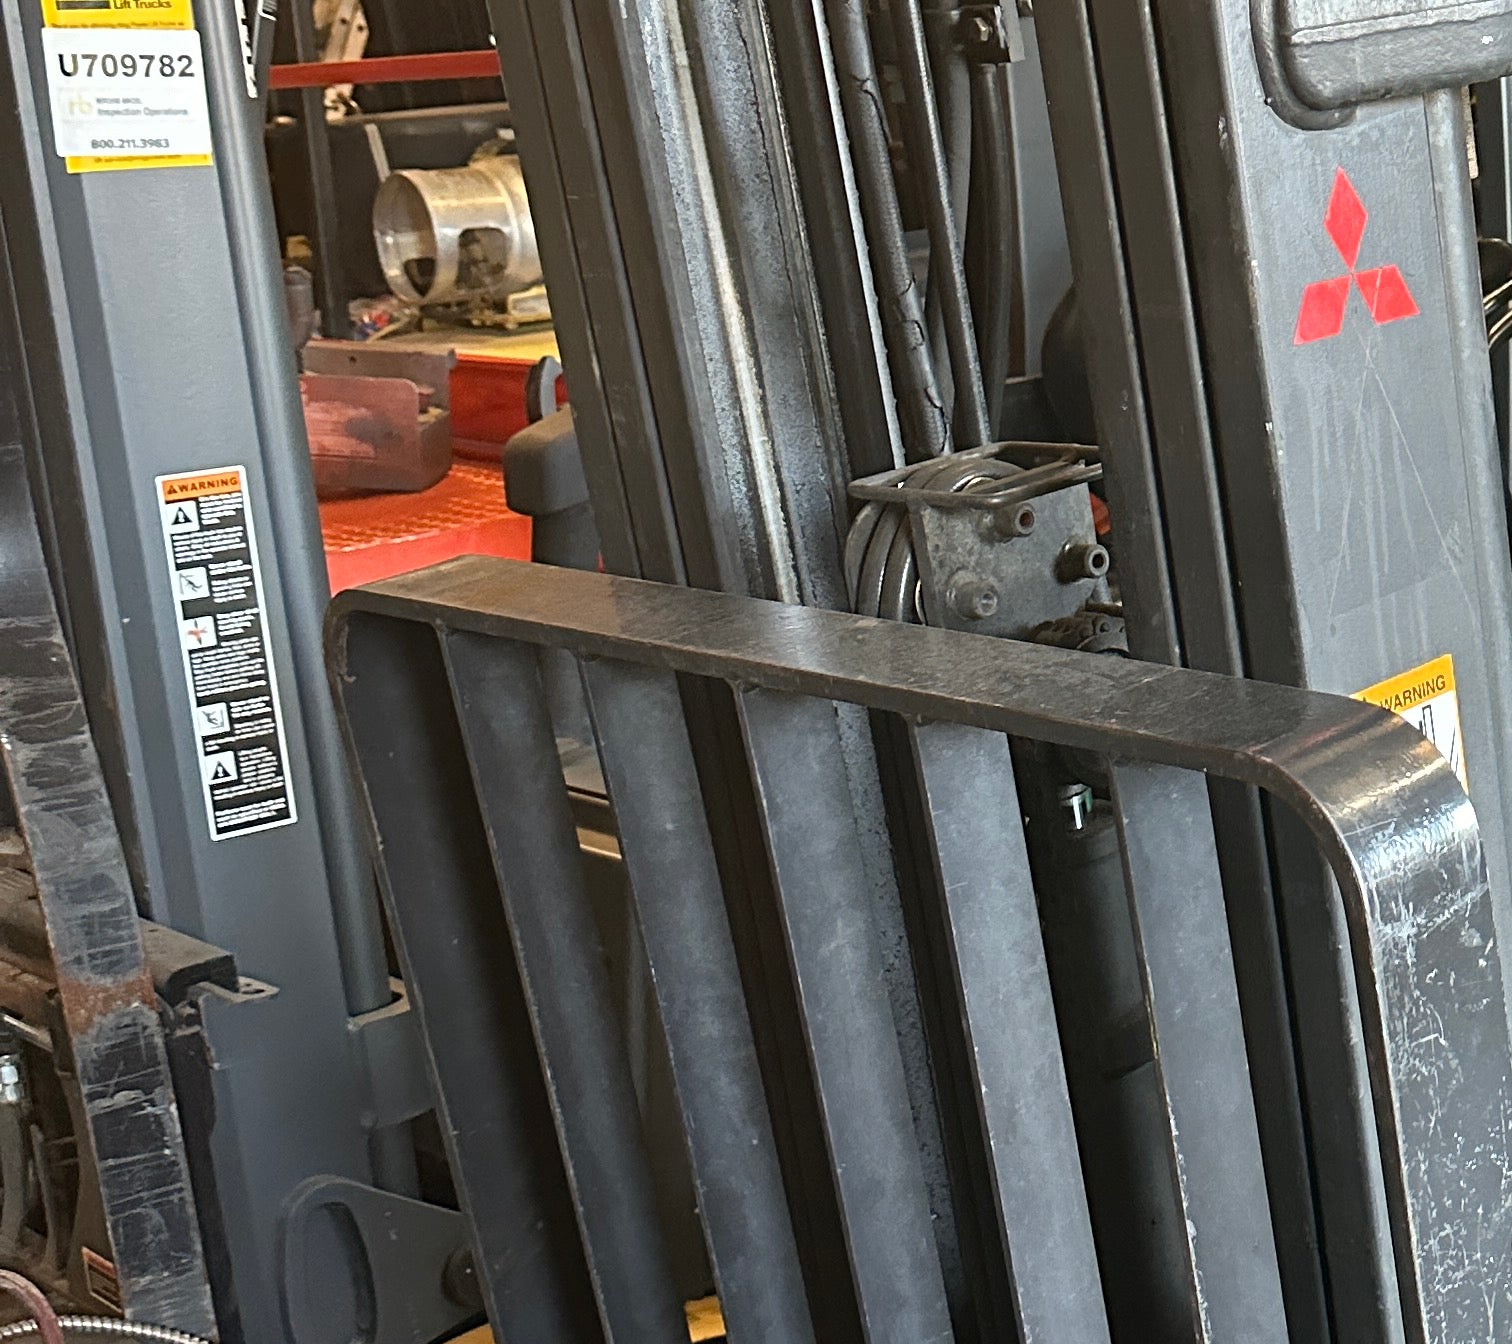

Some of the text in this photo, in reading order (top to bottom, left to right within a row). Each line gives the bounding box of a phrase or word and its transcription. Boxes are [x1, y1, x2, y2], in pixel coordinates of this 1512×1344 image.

[113, 0, 172, 10] Lift Trucks
[57, 53, 196, 78] U709782
[177, 477, 239, 493] WARNING
